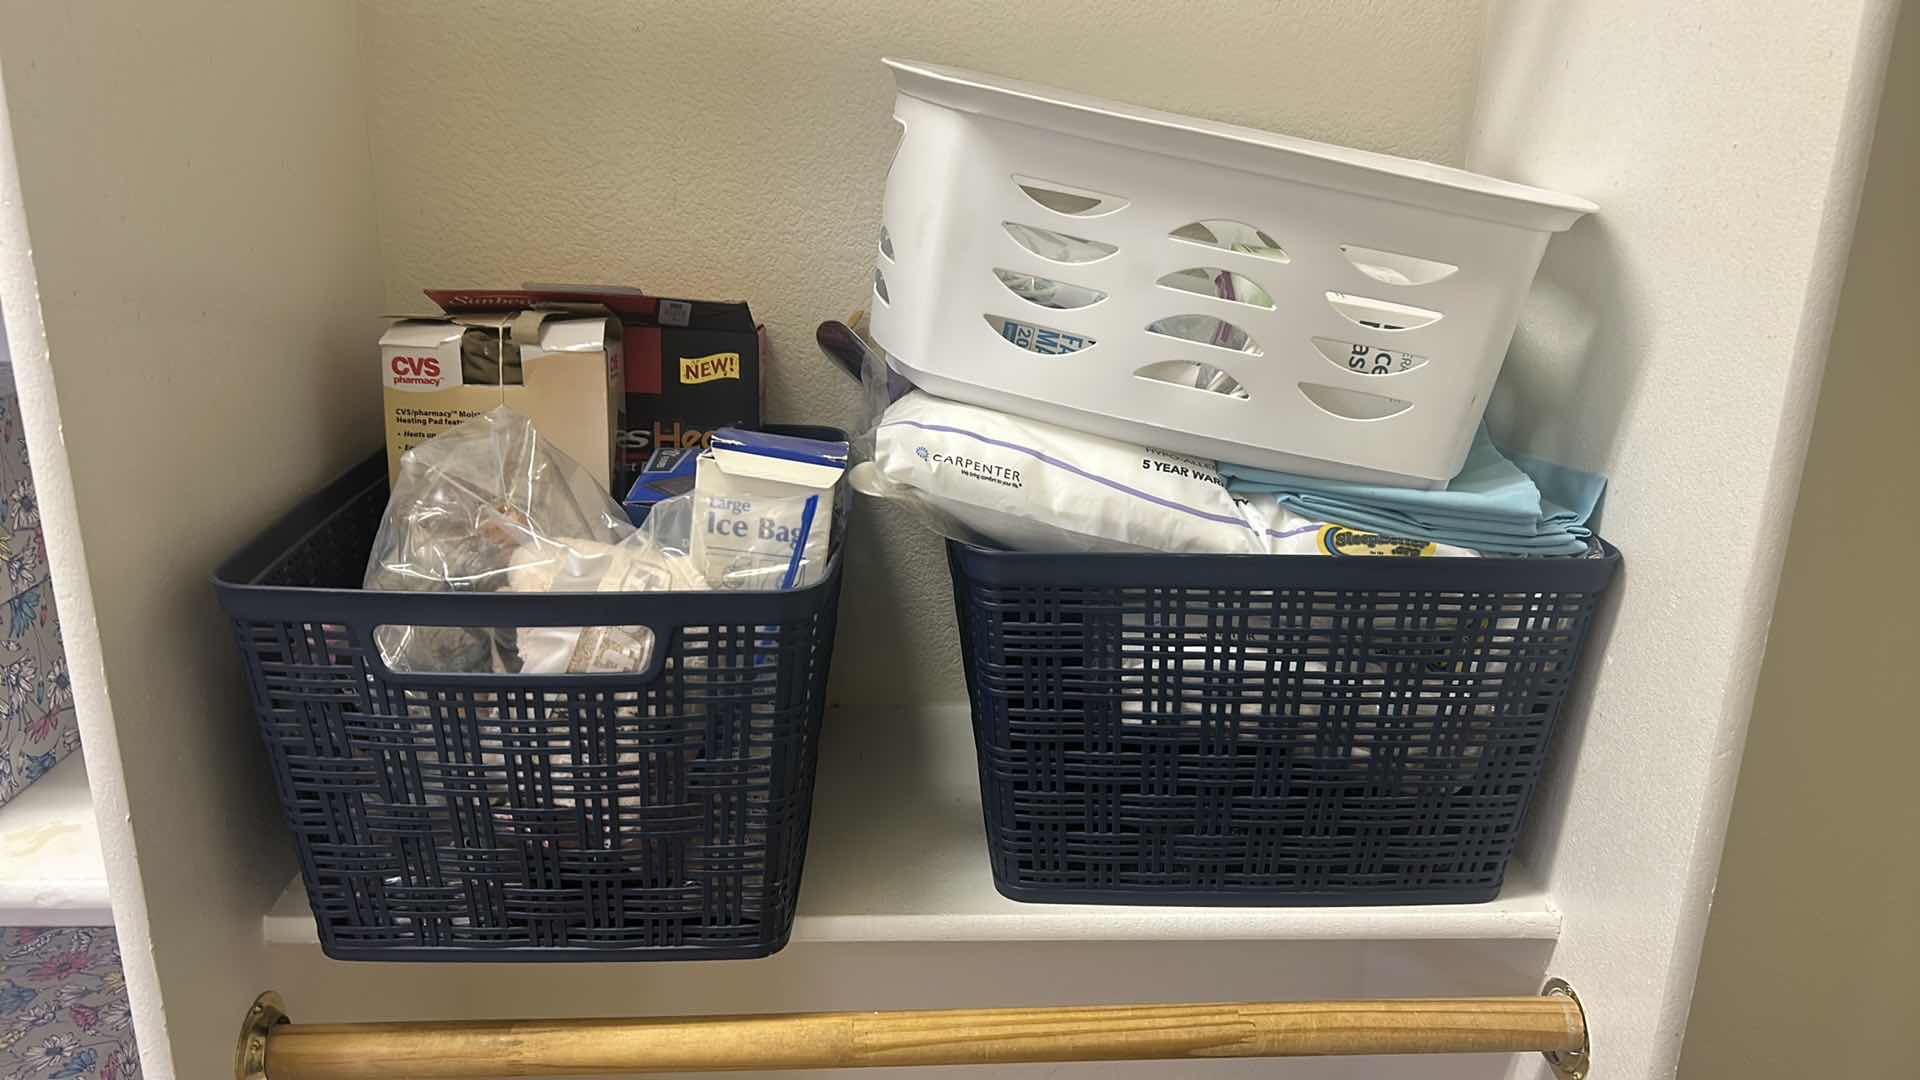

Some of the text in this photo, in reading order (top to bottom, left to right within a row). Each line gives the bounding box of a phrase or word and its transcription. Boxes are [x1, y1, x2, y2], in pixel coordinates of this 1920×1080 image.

[391, 356, 441, 377] CVS
[684, 356, 736, 380] NEW!
[932, 453, 1021, 482] CARPENTER
[1142, 459, 1151, 469] 5
[1153, 461, 1190, 477] YEAR
[709, 497, 751, 514] Large
[707, 511, 748, 538] Ice
